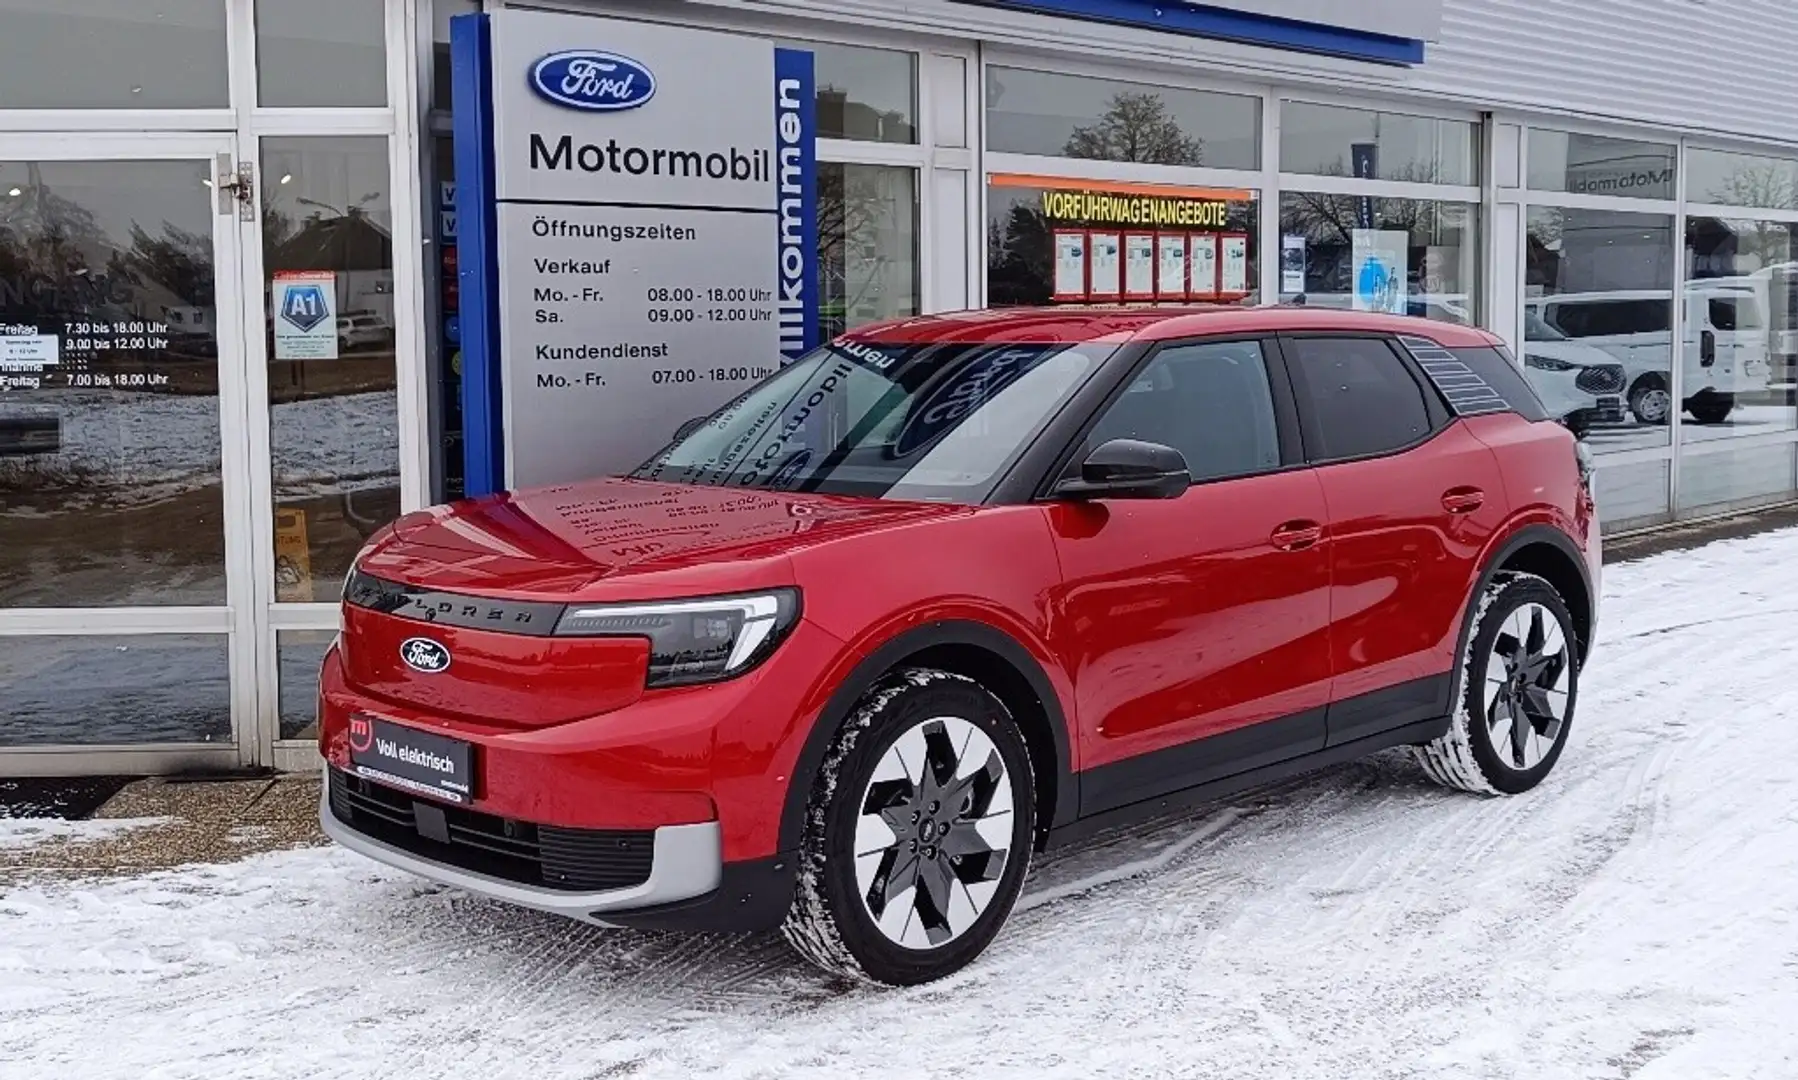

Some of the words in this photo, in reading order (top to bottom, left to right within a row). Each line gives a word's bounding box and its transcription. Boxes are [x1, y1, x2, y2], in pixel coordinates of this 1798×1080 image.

[560, 59, 636, 100] Ford
[529, 133, 770, 182] Motormobil
[1043, 190, 1226, 226] VORFÜHRWAGENANGEBOTE
[532, 216, 697, 242] Öffnungszeiten
[534, 258, 611, 275] Verkauf
[291, 293, 317, 316] A1
[534, 288, 569, 302] Mo.
[583, 288, 604, 302] Fr.
[647, 288, 694, 302] 08.00
[708, 288, 745, 301] 18.00
[749, 288, 772, 301] Uhr
[535, 309, 564, 324] Sa.
[647, 309, 694, 322] 09.00
[708, 309, 745, 322] 12.00
[749, 309, 772, 322] Uhr
[65, 323, 90, 334] 7.30
[93, 323, 110, 334] bis
[113, 322, 143, 334] 18.00
[147, 322, 168, 333] Uhr
[66, 339, 91, 350] 9.00
[94, 339, 110, 350] bis
[114, 338, 144, 350] 12.00
[147, 338, 168, 349] Uhr
[536, 343, 669, 361] Kundendienst
[67, 374, 91, 386] 7.00
[94, 374, 110, 386] bis
[114, 374, 144, 386] 18.00
[147, 373, 168, 385] Uhr
[537, 373, 571, 388] Mo.
[585, 373, 606, 387] Fr.
[652, 369, 697, 384] 07.00
[708, 368, 747, 382] 18.00
[751, 366, 773, 380] Uhr
[407, 640, 440, 668] Ford
[376, 738, 398, 760] Voll
[399, 743, 455, 774] elektrisch
